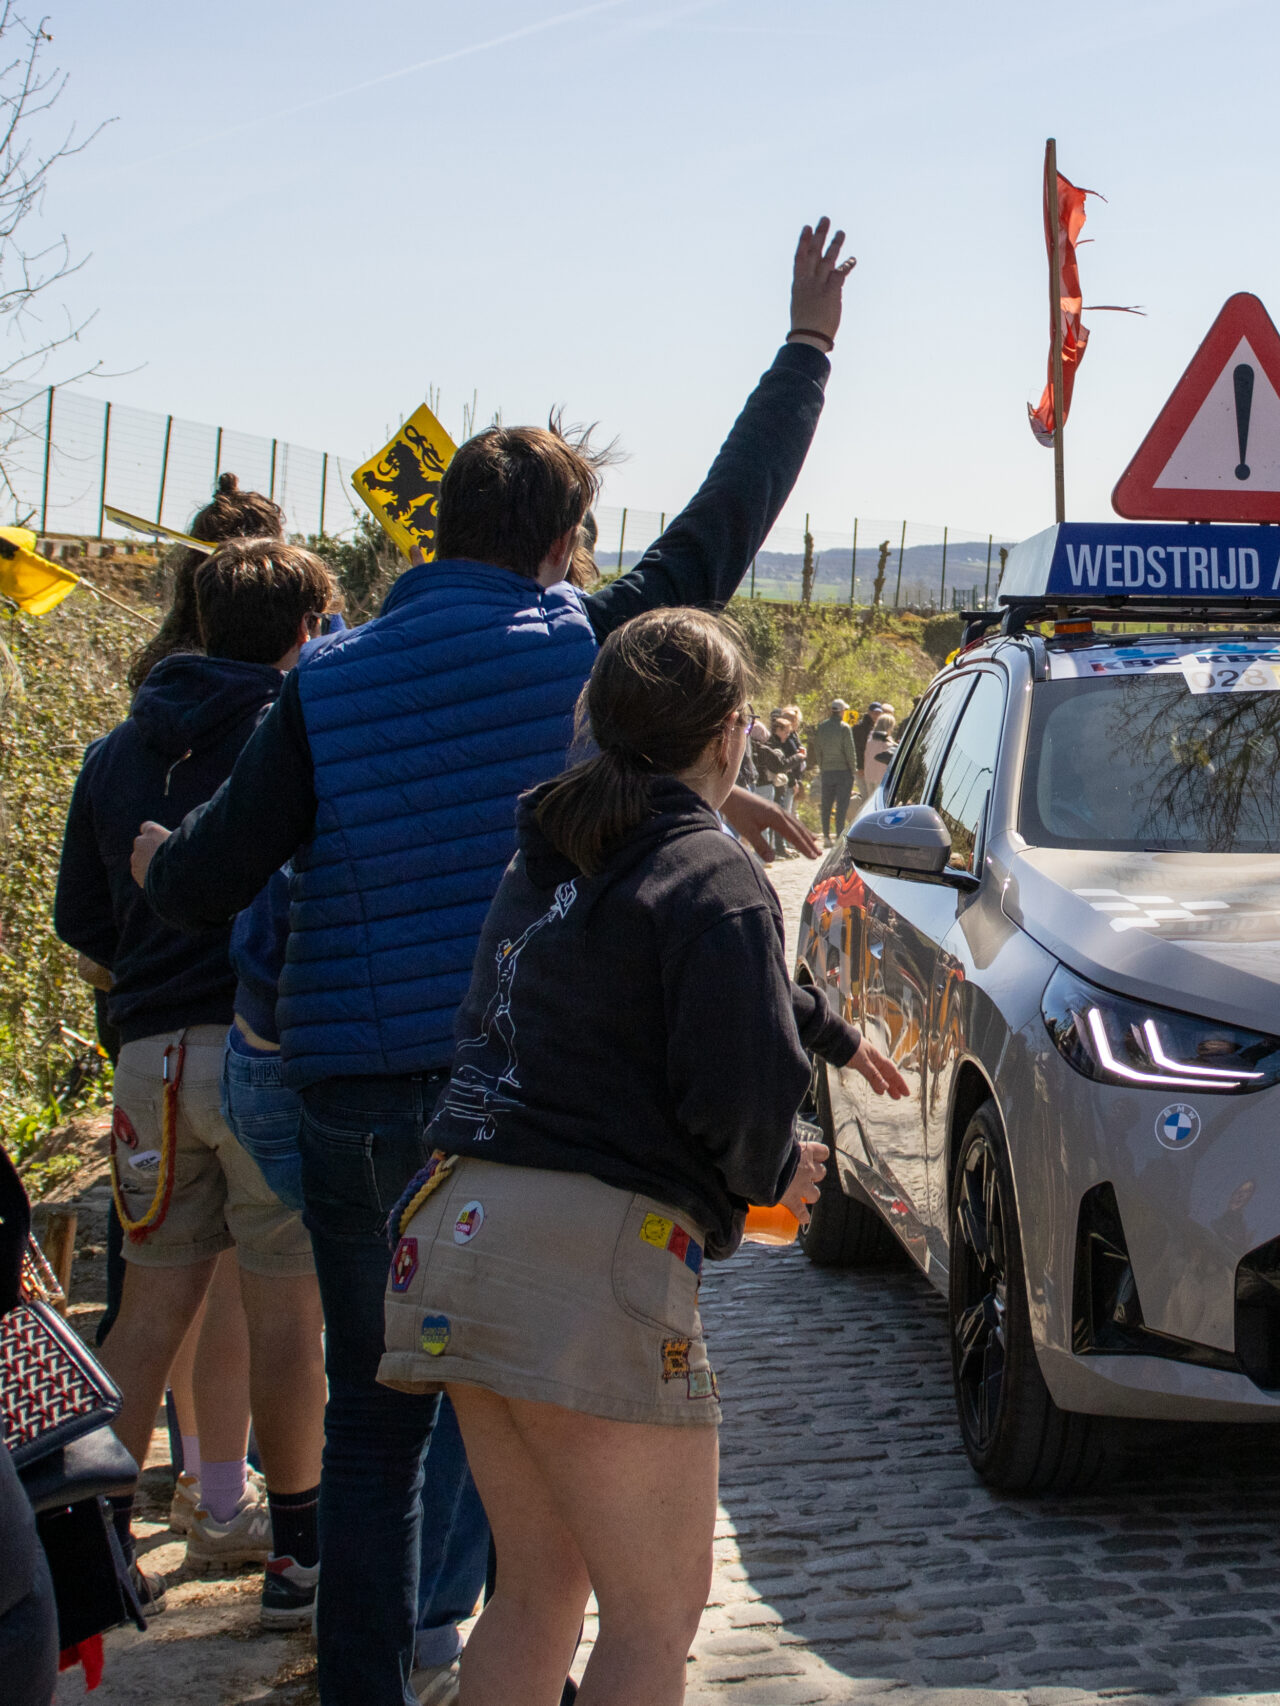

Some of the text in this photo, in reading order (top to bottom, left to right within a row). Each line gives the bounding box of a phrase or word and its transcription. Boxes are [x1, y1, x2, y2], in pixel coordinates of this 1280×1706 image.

[1066, 544, 1260, 590] WEDSTRIJD
[1090, 657, 1182, 672] KBC
[1191, 669, 1269, 689] 028
